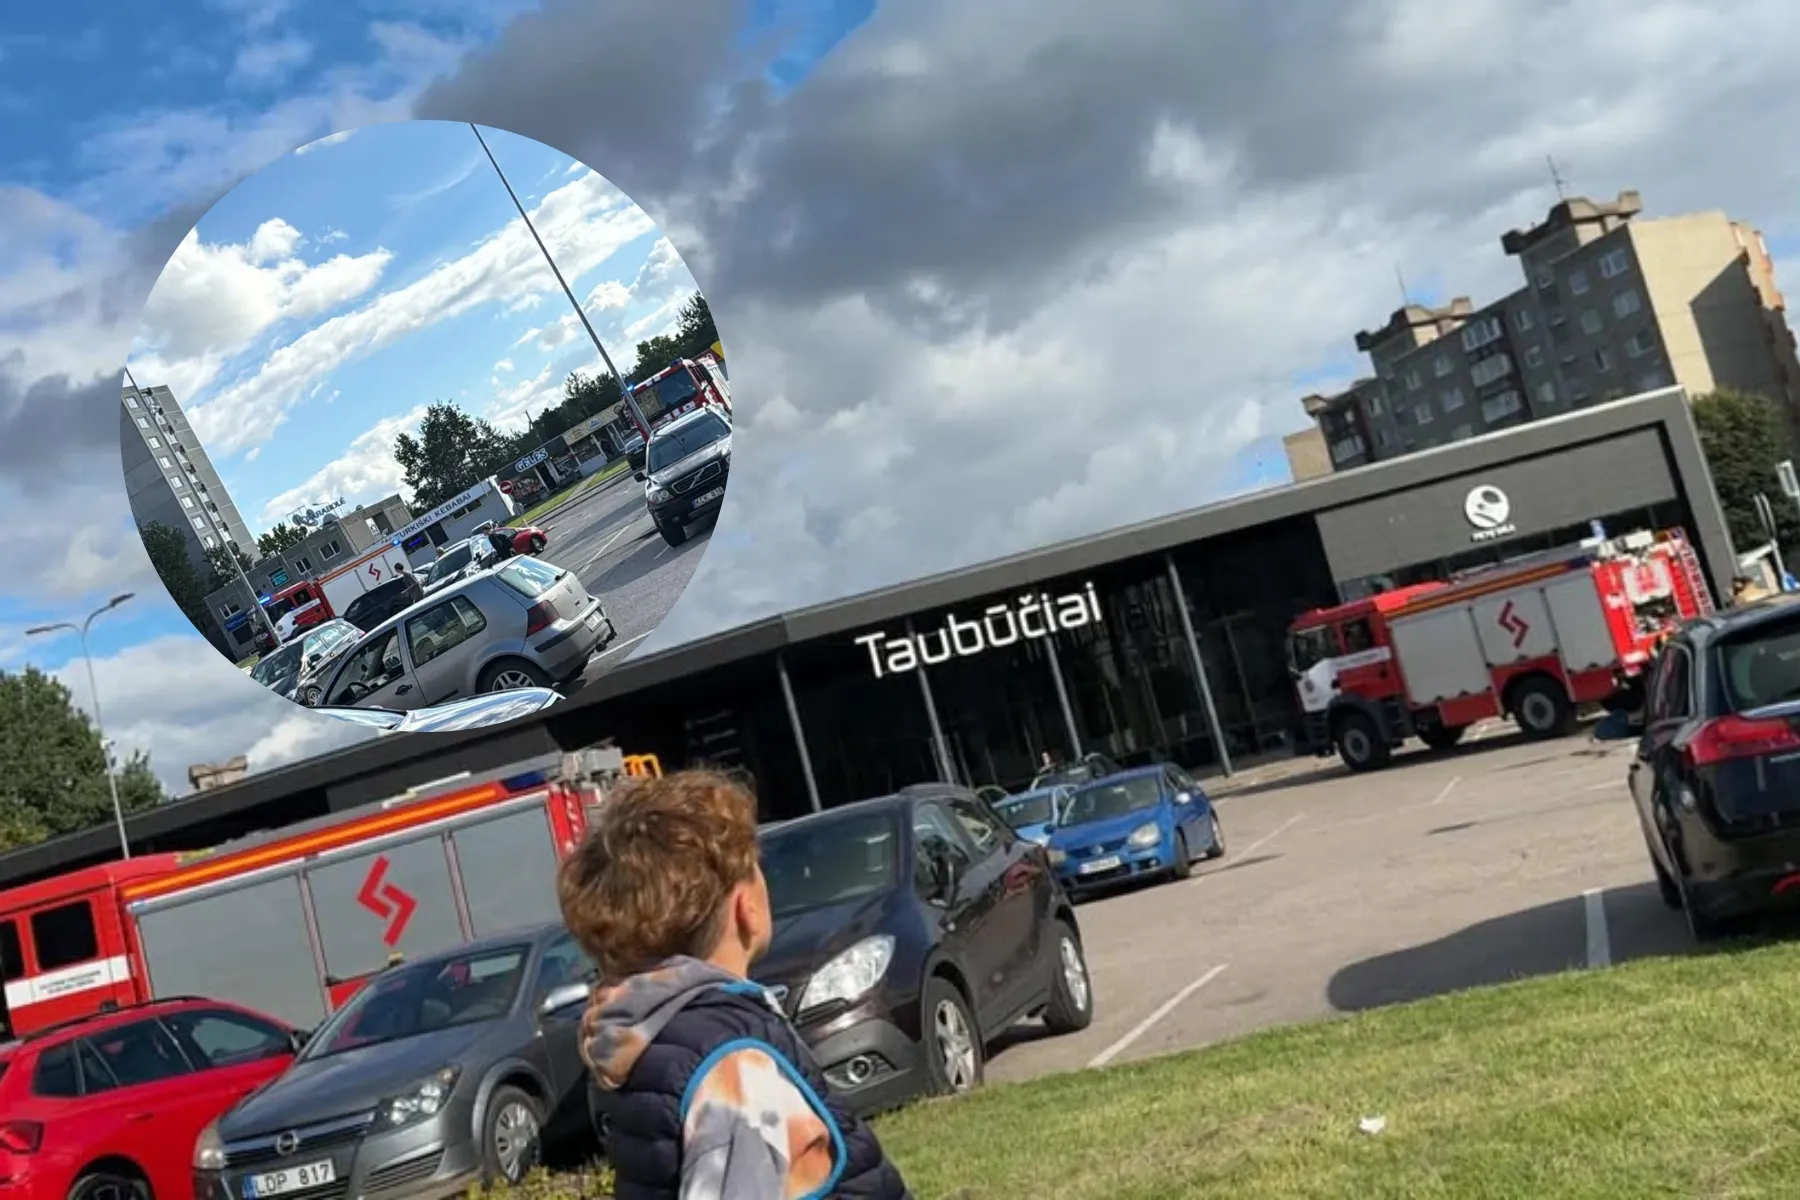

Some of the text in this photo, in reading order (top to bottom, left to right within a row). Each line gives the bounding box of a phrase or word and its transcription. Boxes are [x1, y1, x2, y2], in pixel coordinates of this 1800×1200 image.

[434, 493, 472, 518] KEBABAI
[854, 581, 1102, 679] Taubūčiai
[255, 1164, 329, 1194] LDP 817
